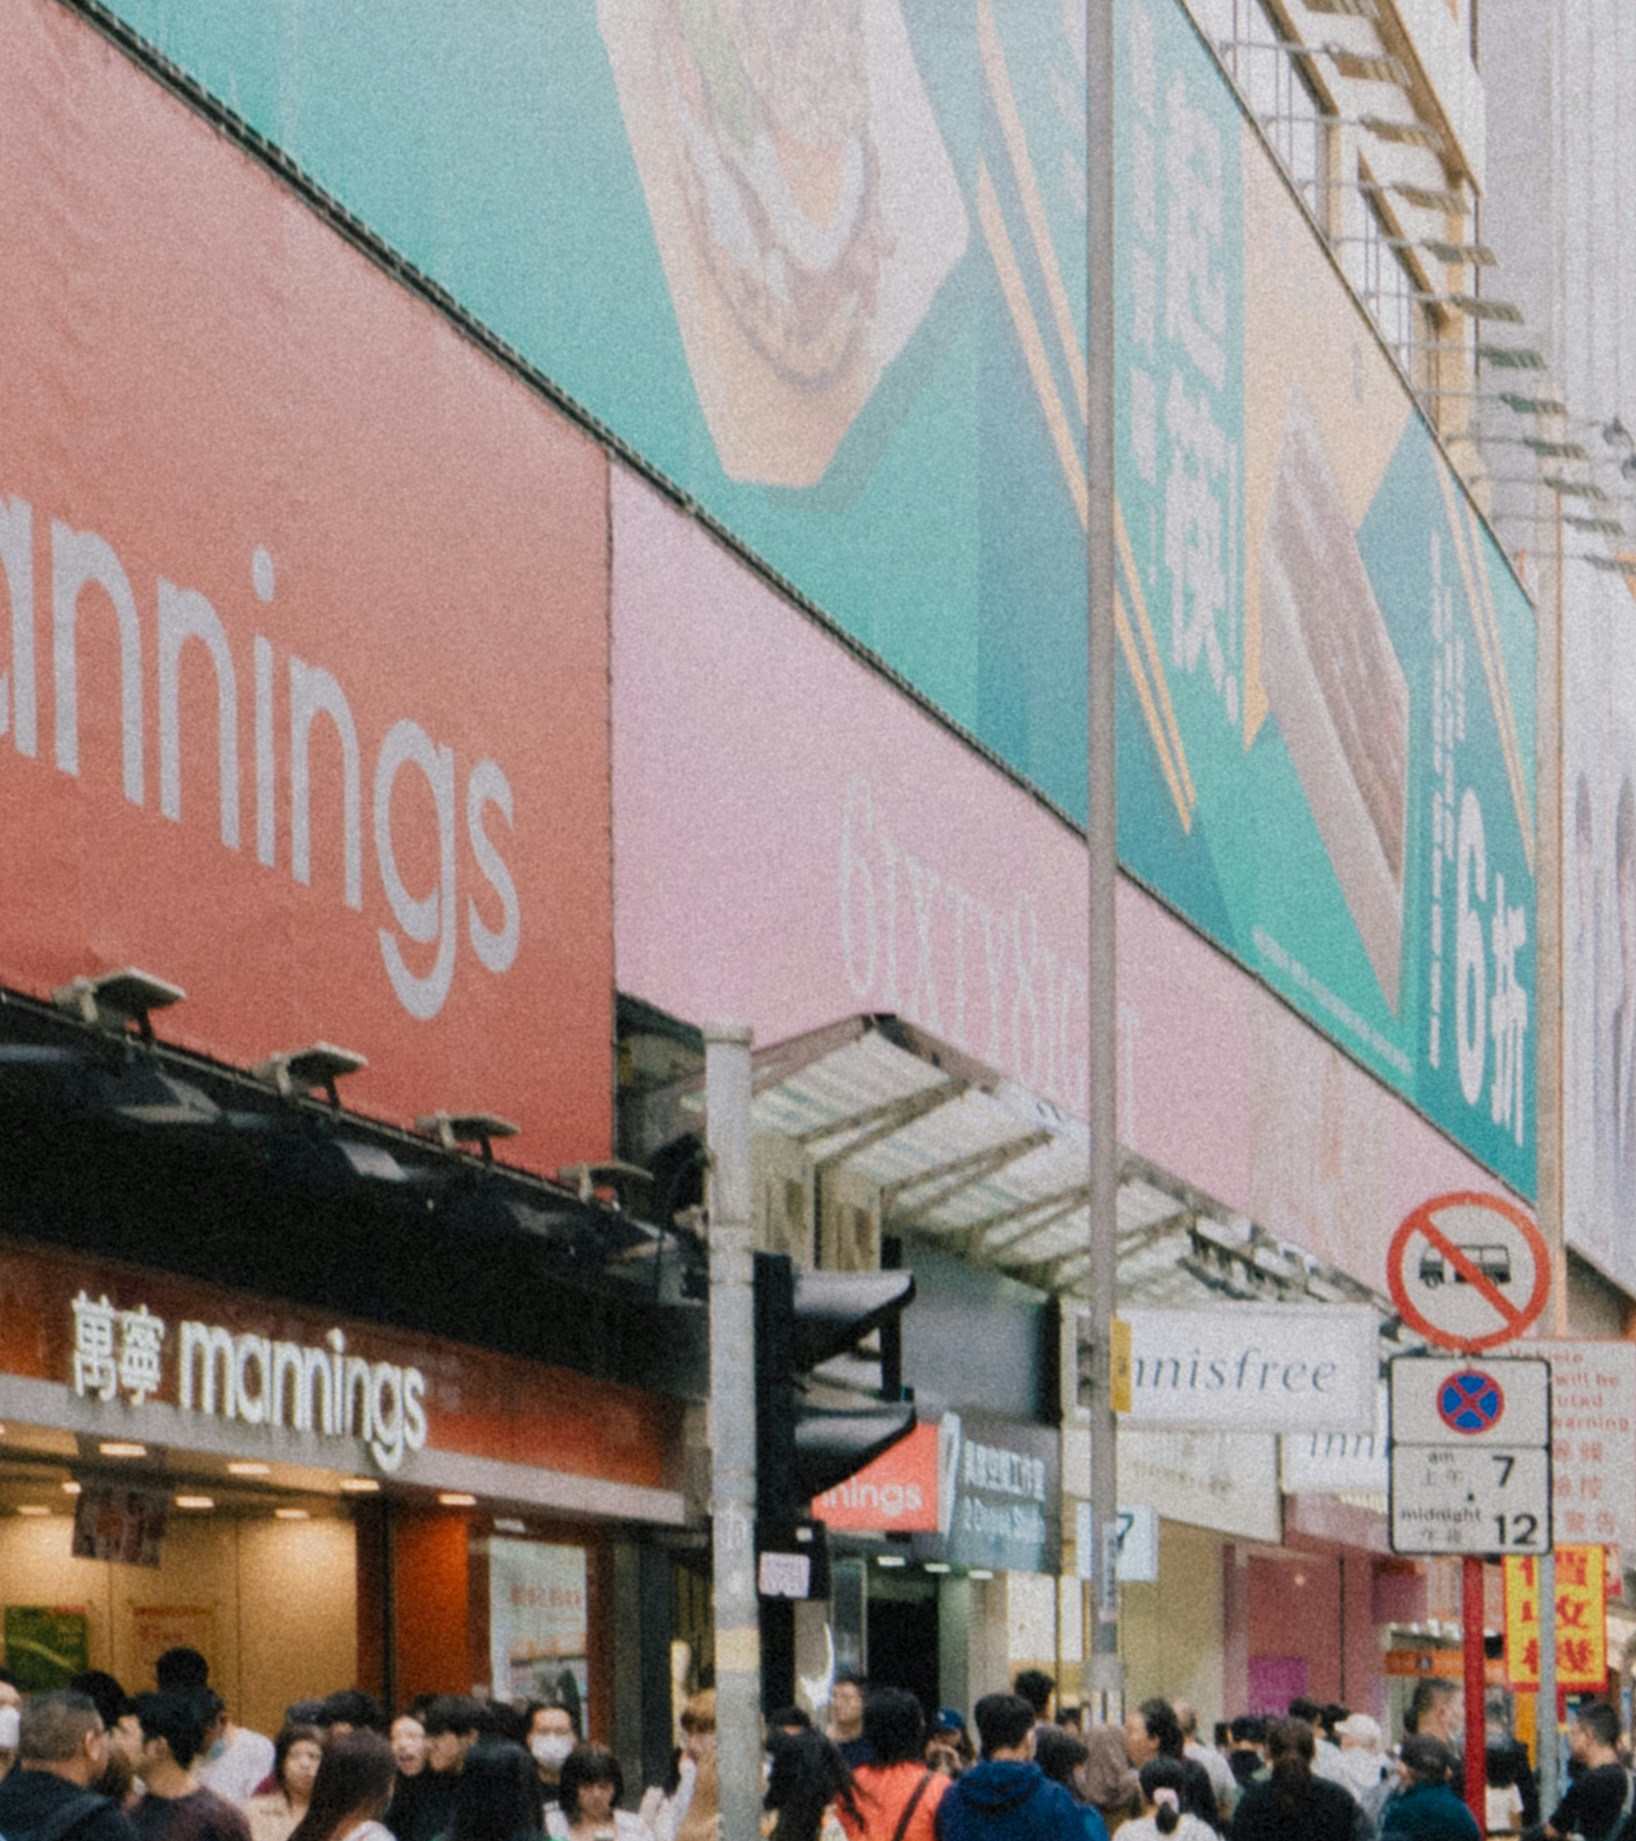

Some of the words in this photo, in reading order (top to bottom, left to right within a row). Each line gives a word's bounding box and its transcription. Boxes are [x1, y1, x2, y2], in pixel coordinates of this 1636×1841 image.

[840, 774, 1140, 1148] 6IXTY8IGT
[72, 1289, 165, 1405] 萬寧
[179, 1319, 427, 1472] mannings
[1401, 1507, 1481, 1526] midnight
[1494, 1513, 1538, 1546] 12
[1491, 1455, 1515, 1487] 7
